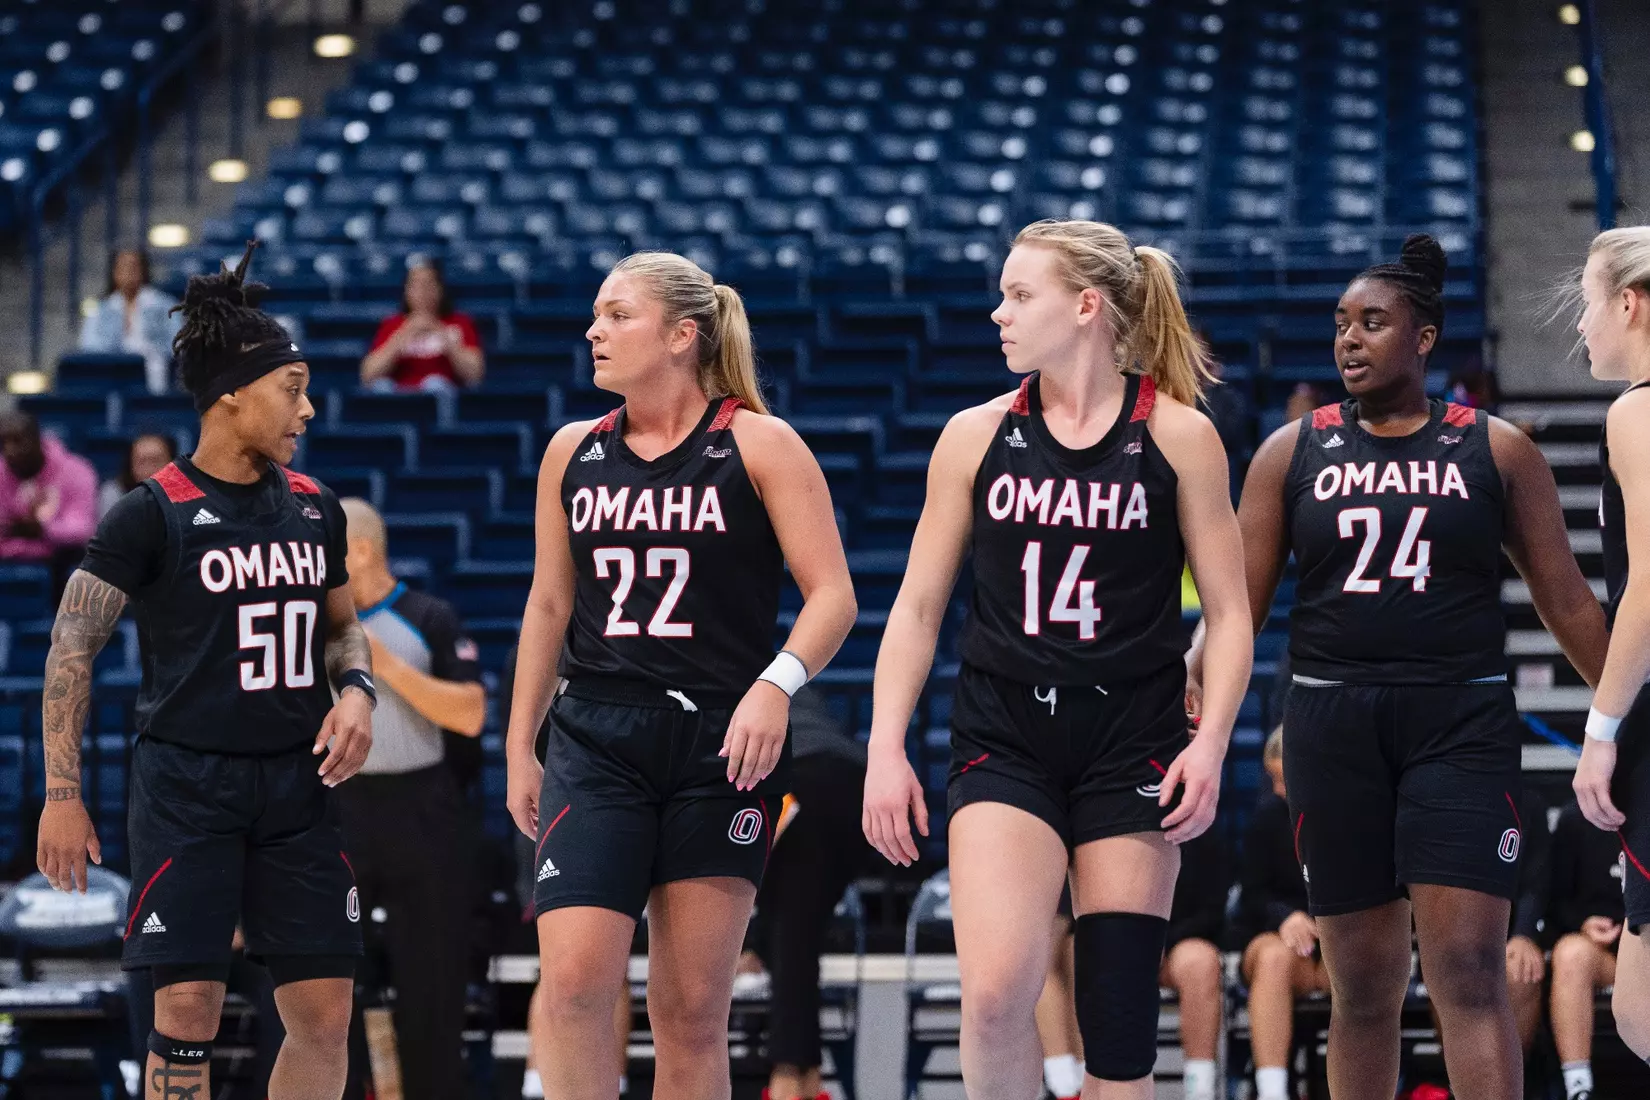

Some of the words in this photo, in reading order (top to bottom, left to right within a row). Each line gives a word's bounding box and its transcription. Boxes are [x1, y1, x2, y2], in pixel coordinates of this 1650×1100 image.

[580, 453, 606, 462] adidas
[1313, 460, 1469, 501] OMAHA
[192, 516, 221, 526] adidas
[571, 485, 726, 533] OMAHA
[987, 473, 1149, 530] OMAHA
[200, 541, 327, 593] OMAHA
[1337, 506, 1431, 593] 24
[592, 547, 693, 637] 22
[1021, 541, 1101, 640] 14
[238, 600, 317, 691] 50
[537, 869, 561, 882] adidas
[141, 924, 167, 934] adidas
